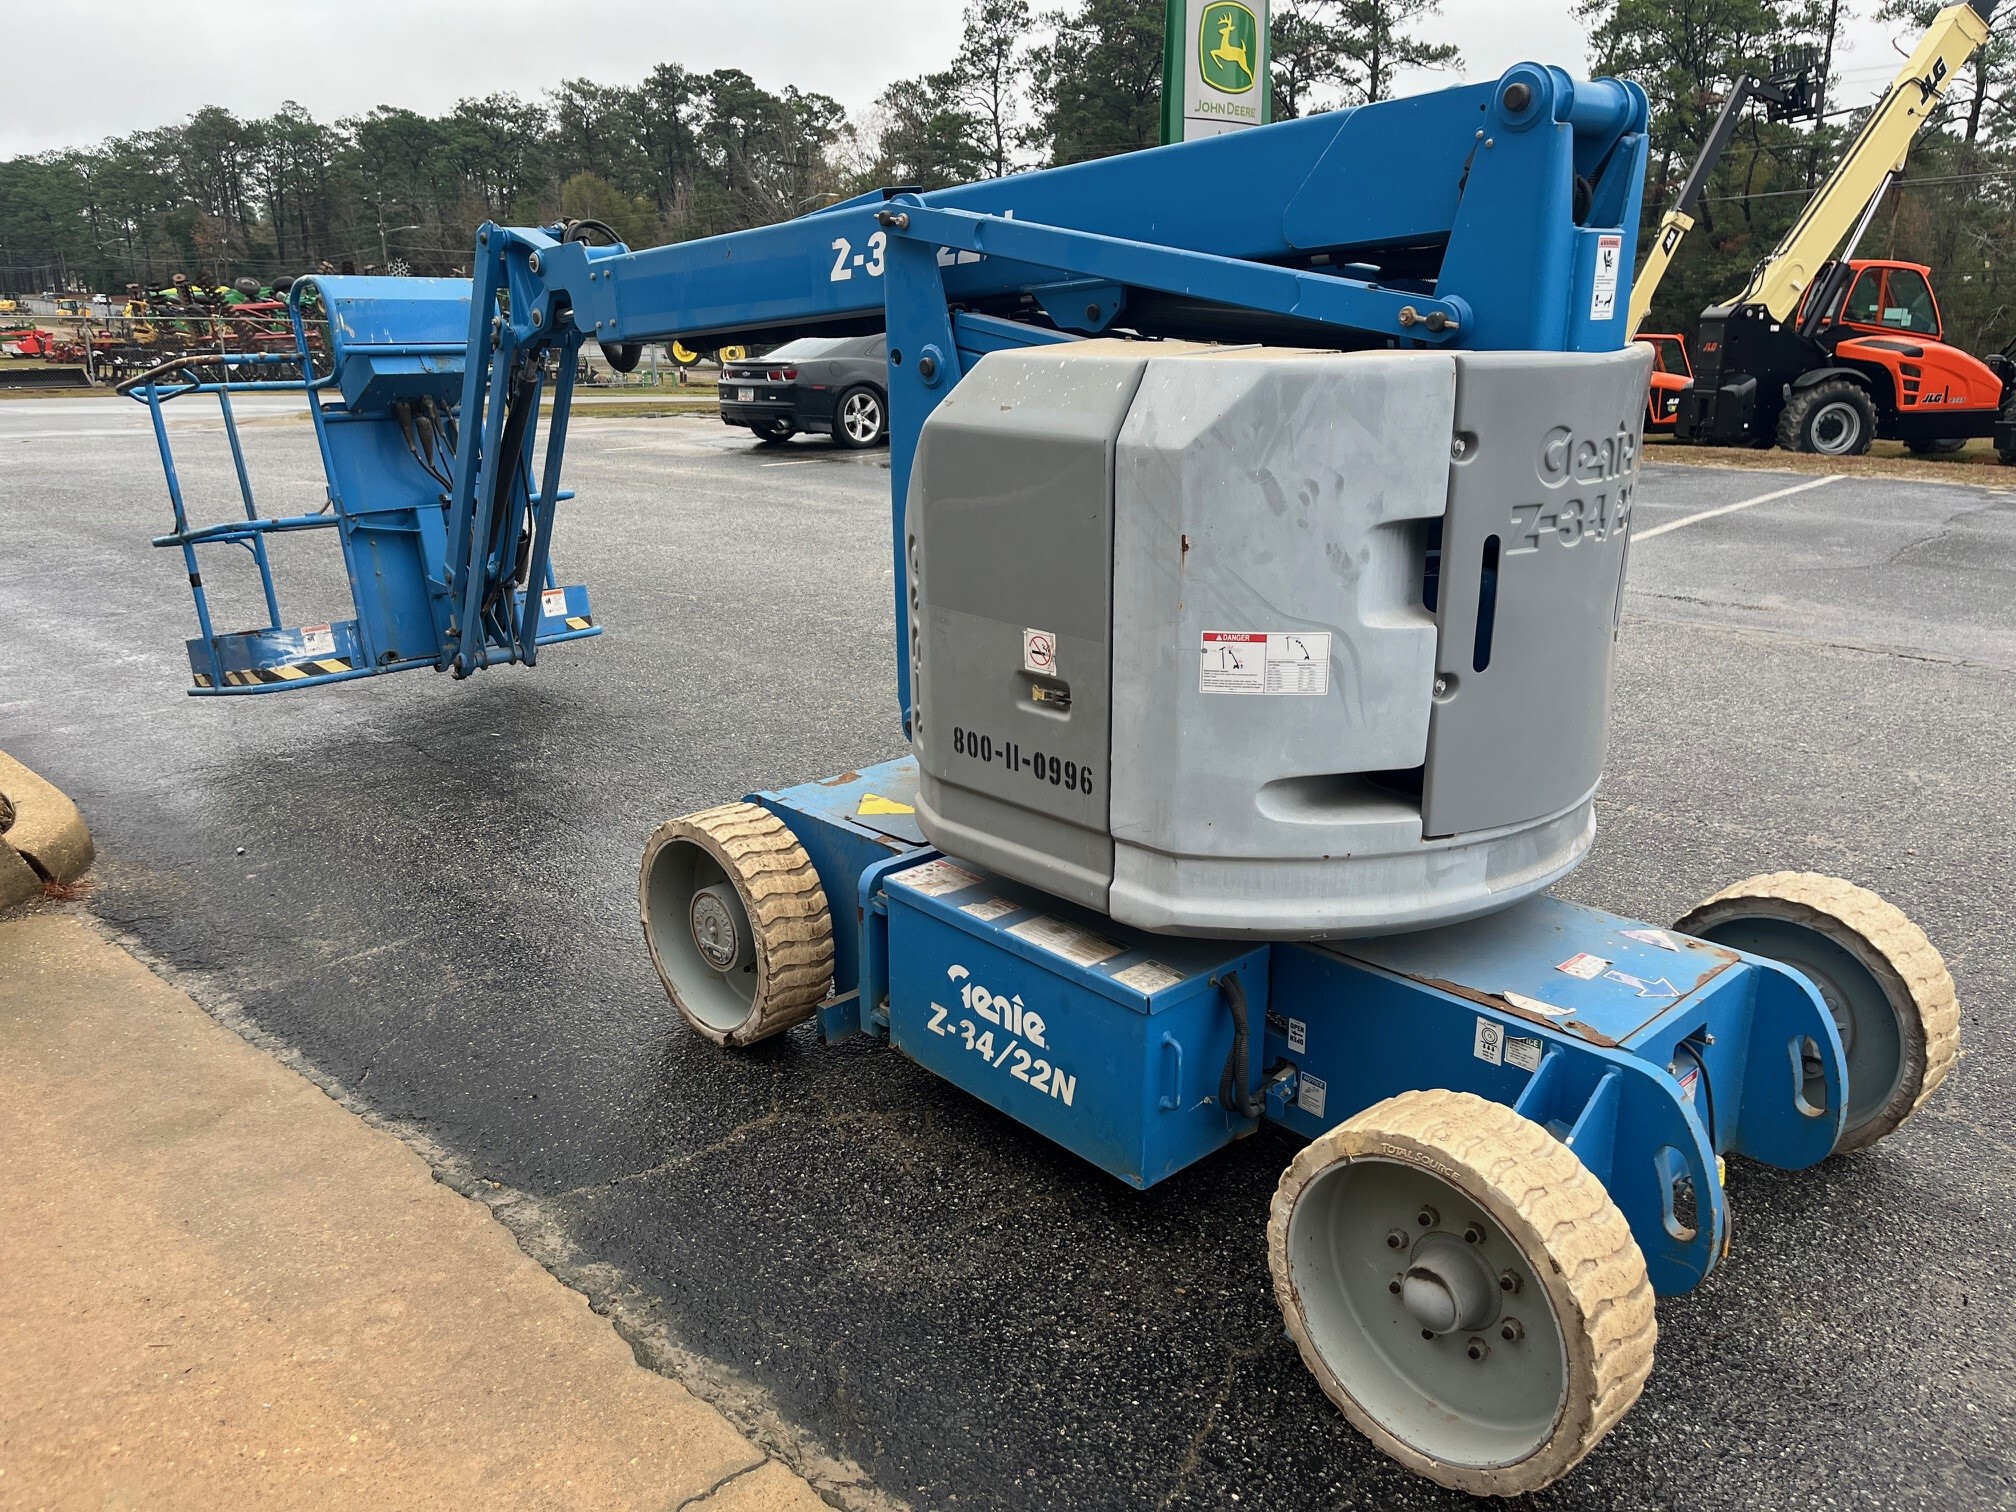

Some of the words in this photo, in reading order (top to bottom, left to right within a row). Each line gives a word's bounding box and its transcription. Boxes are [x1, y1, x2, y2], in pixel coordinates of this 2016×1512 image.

[1194, 99, 1226, 114] JOHN
[1226, 102, 1256, 118] DEERE
[1921, 392, 1943, 403] JLG
[1222, 634, 1250, 642] DANGER
[953, 726, 1093, 795] 800-11-0996
[927, 1002, 1077, 1107] Z-34/22N
[1303, 1074, 1325, 1088] NOTICE
[1381, 1143, 1413, 1159] TOTAL
[1414, 1152, 1461, 1181] SOURCE
